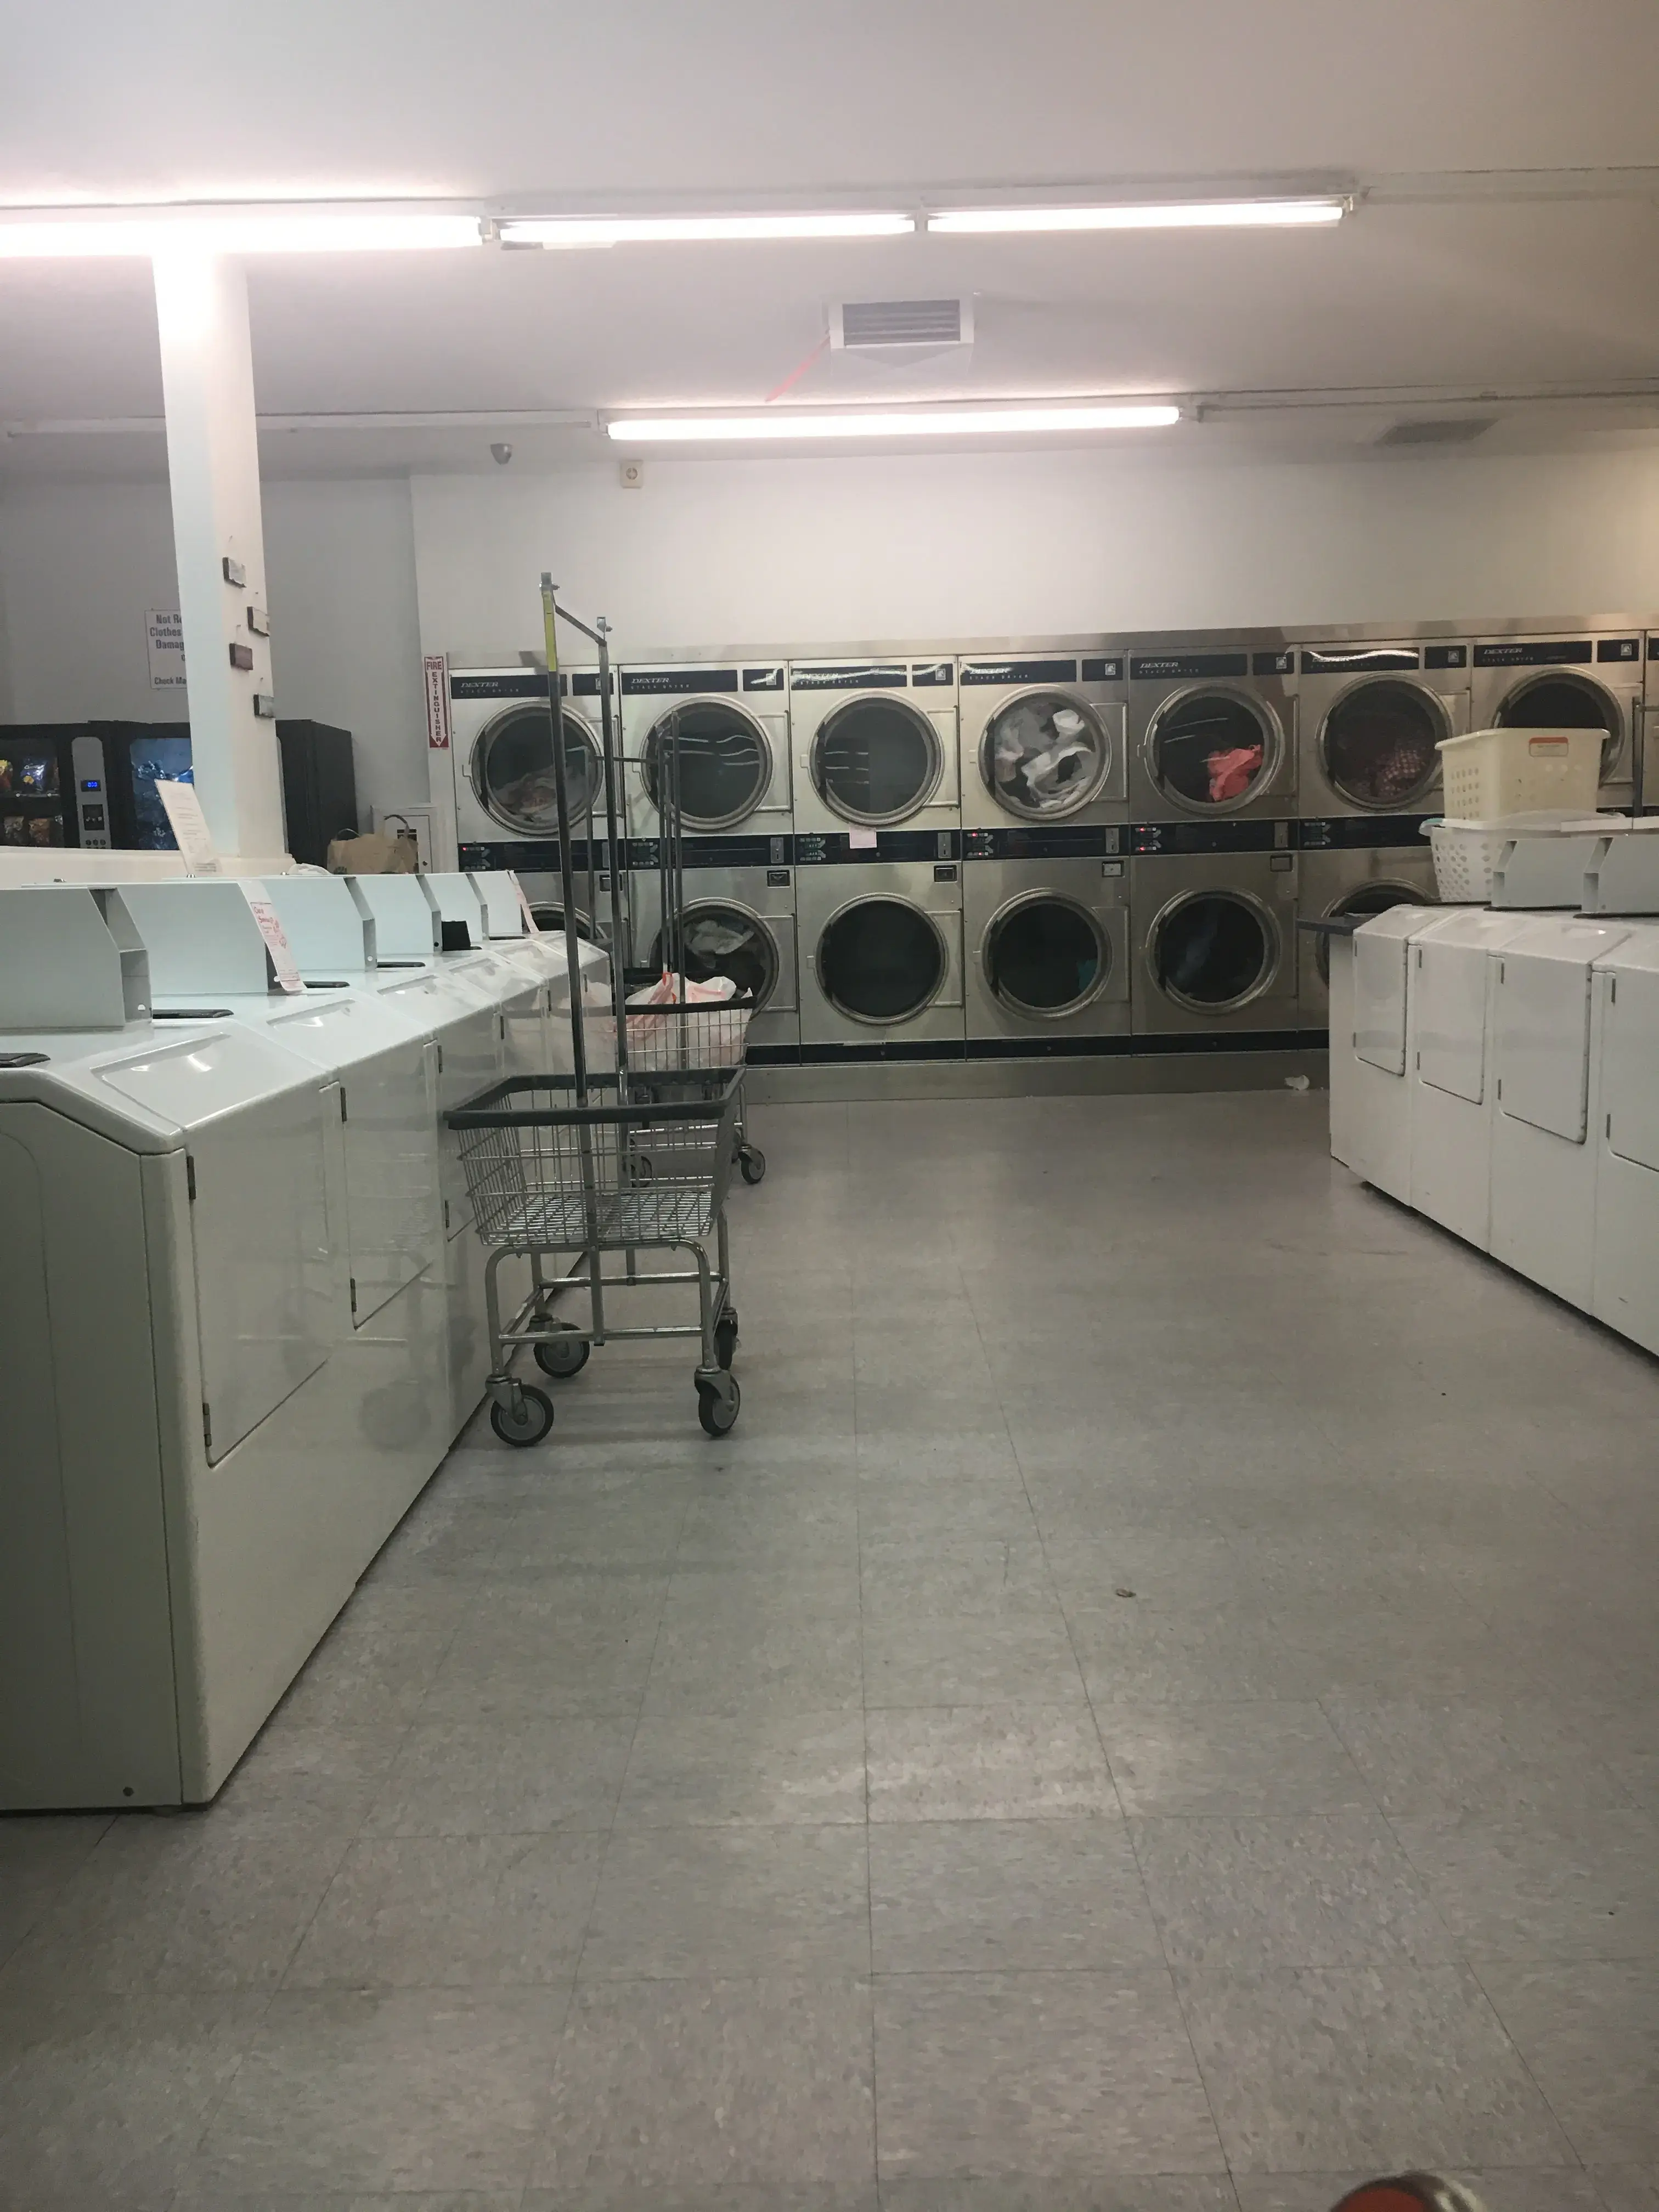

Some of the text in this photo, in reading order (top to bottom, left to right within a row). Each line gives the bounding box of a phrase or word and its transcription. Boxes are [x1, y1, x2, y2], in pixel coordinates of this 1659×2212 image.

[156, 614, 171, 624] Not
[150, 627, 182, 636] Clothes
[426, 661, 442, 670] FIRE
[154, 676, 174, 685] Check
[432, 672, 442, 742] EXTINGUISHER
